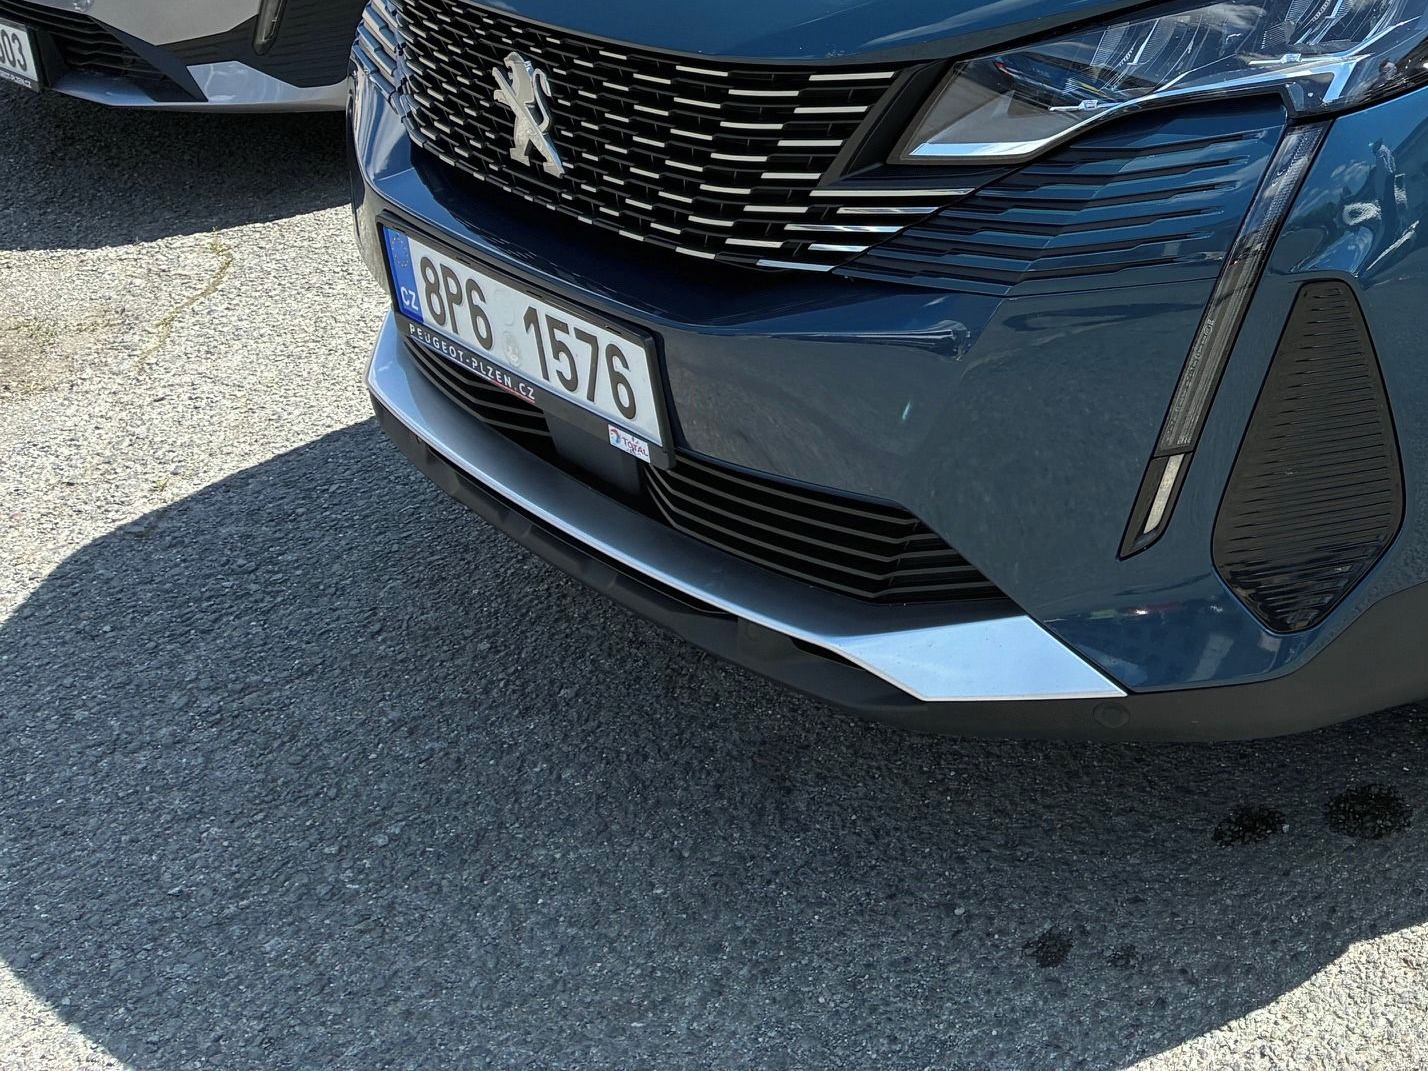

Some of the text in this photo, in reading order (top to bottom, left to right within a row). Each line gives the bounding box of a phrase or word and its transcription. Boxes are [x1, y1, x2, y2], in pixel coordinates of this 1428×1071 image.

[400, 286, 419, 311] CZ
[420, 256, 637, 420] 8P6 1576
[622, 437, 649, 457] TOTAL
